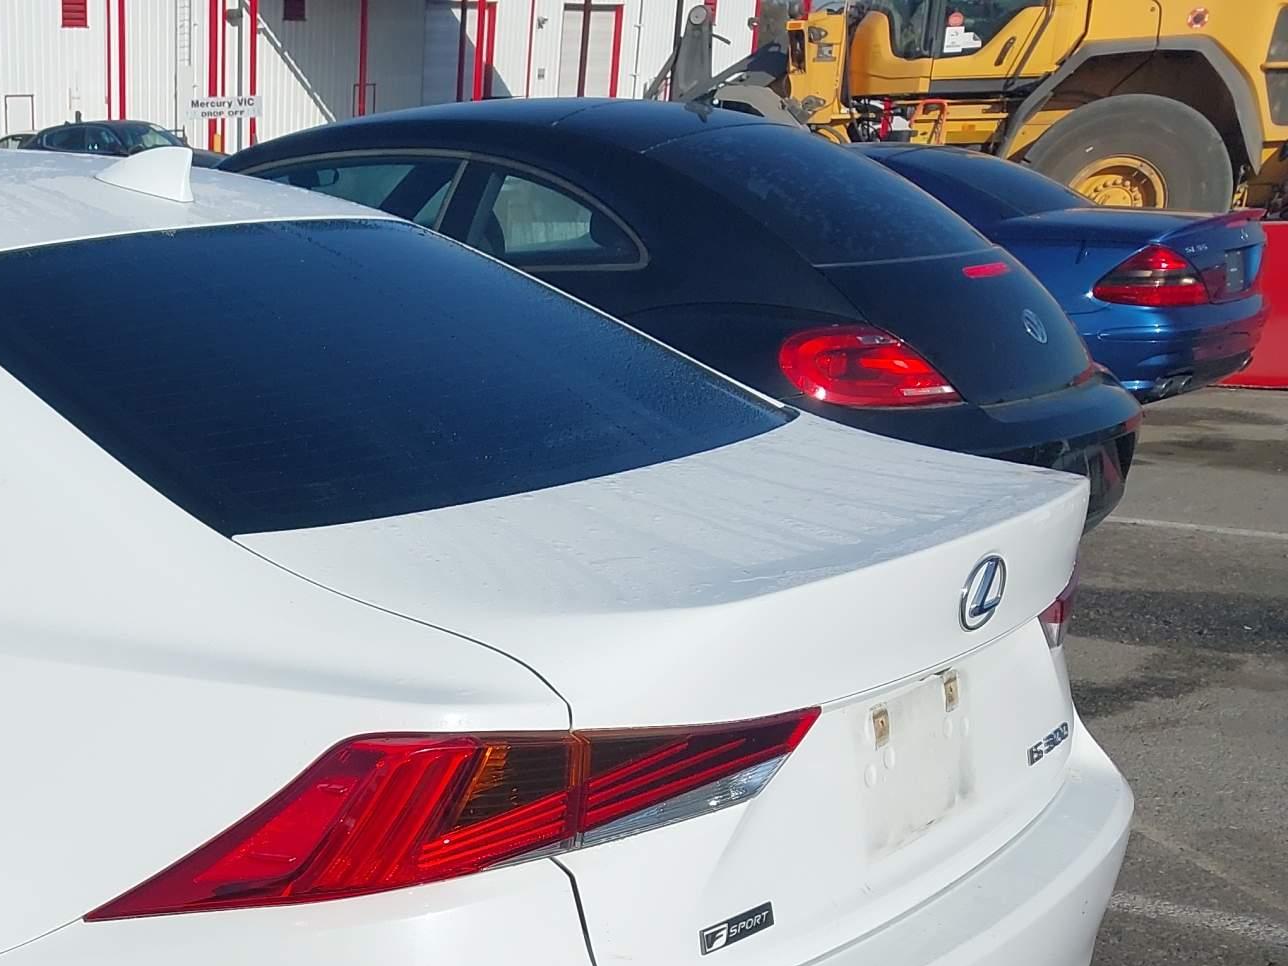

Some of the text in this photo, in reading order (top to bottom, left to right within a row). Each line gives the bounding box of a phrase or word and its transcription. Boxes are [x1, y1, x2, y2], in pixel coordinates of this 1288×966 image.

[191, 97, 255, 109] Mercury VIC
[201, 109, 245, 118] DROP OFF
[1027, 721, 1069, 766] IS 300
[728, 910, 769, 938] SPORT
